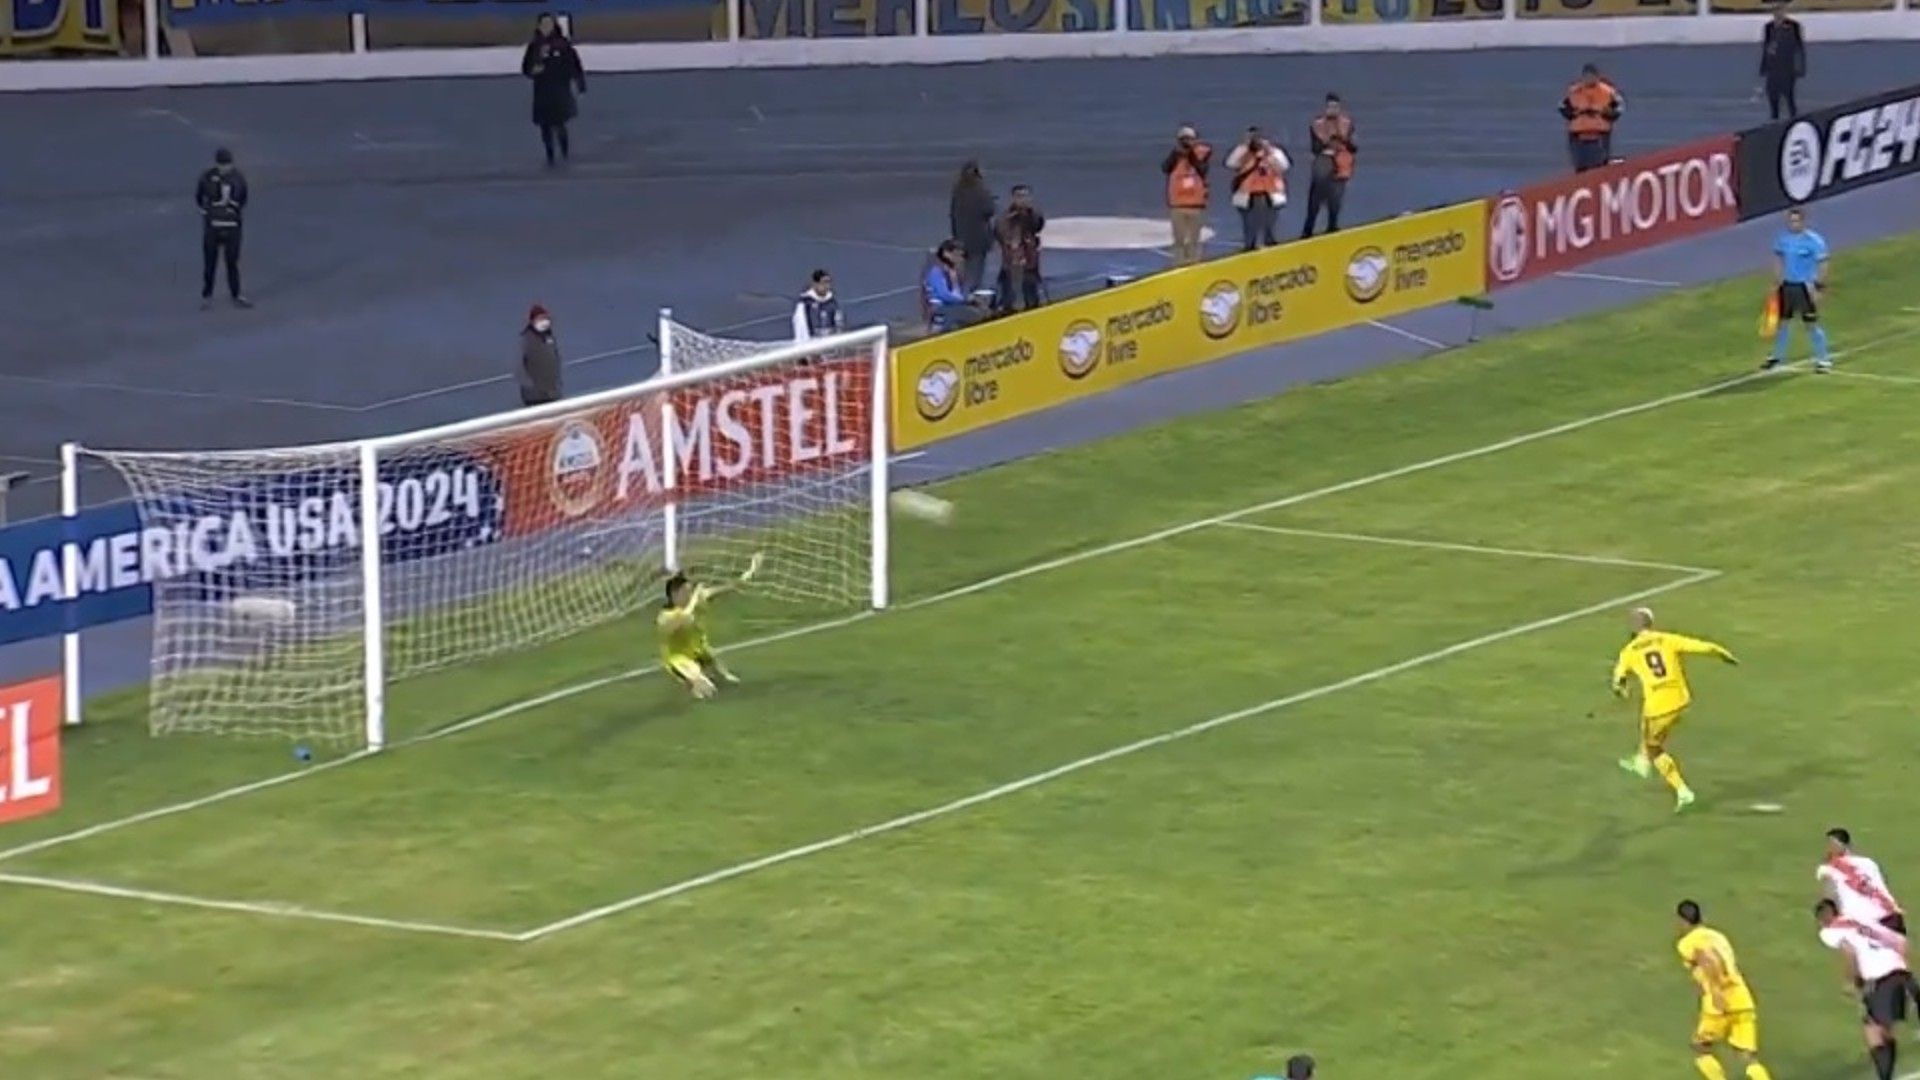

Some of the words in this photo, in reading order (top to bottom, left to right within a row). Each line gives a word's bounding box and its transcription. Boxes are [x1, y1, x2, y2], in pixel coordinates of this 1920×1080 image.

[1536, 188, 1594, 259] MG
[1600, 153, 1737, 241] MOTOR
[1394, 229, 1466, 264] mercado
[1246, 264, 1318, 298] mercado
[1105, 299, 1174, 338] mercado
[964, 336, 1034, 380] mercado
[613, 371, 856, 501] AMSTEL
[24, 510, 257, 607] AMERICA
[266, 491, 359, 556] USA
[377, 467, 480, 535] 2024
[1645, 651, 1667, 678] 9
[0, 699, 52, 804] L
